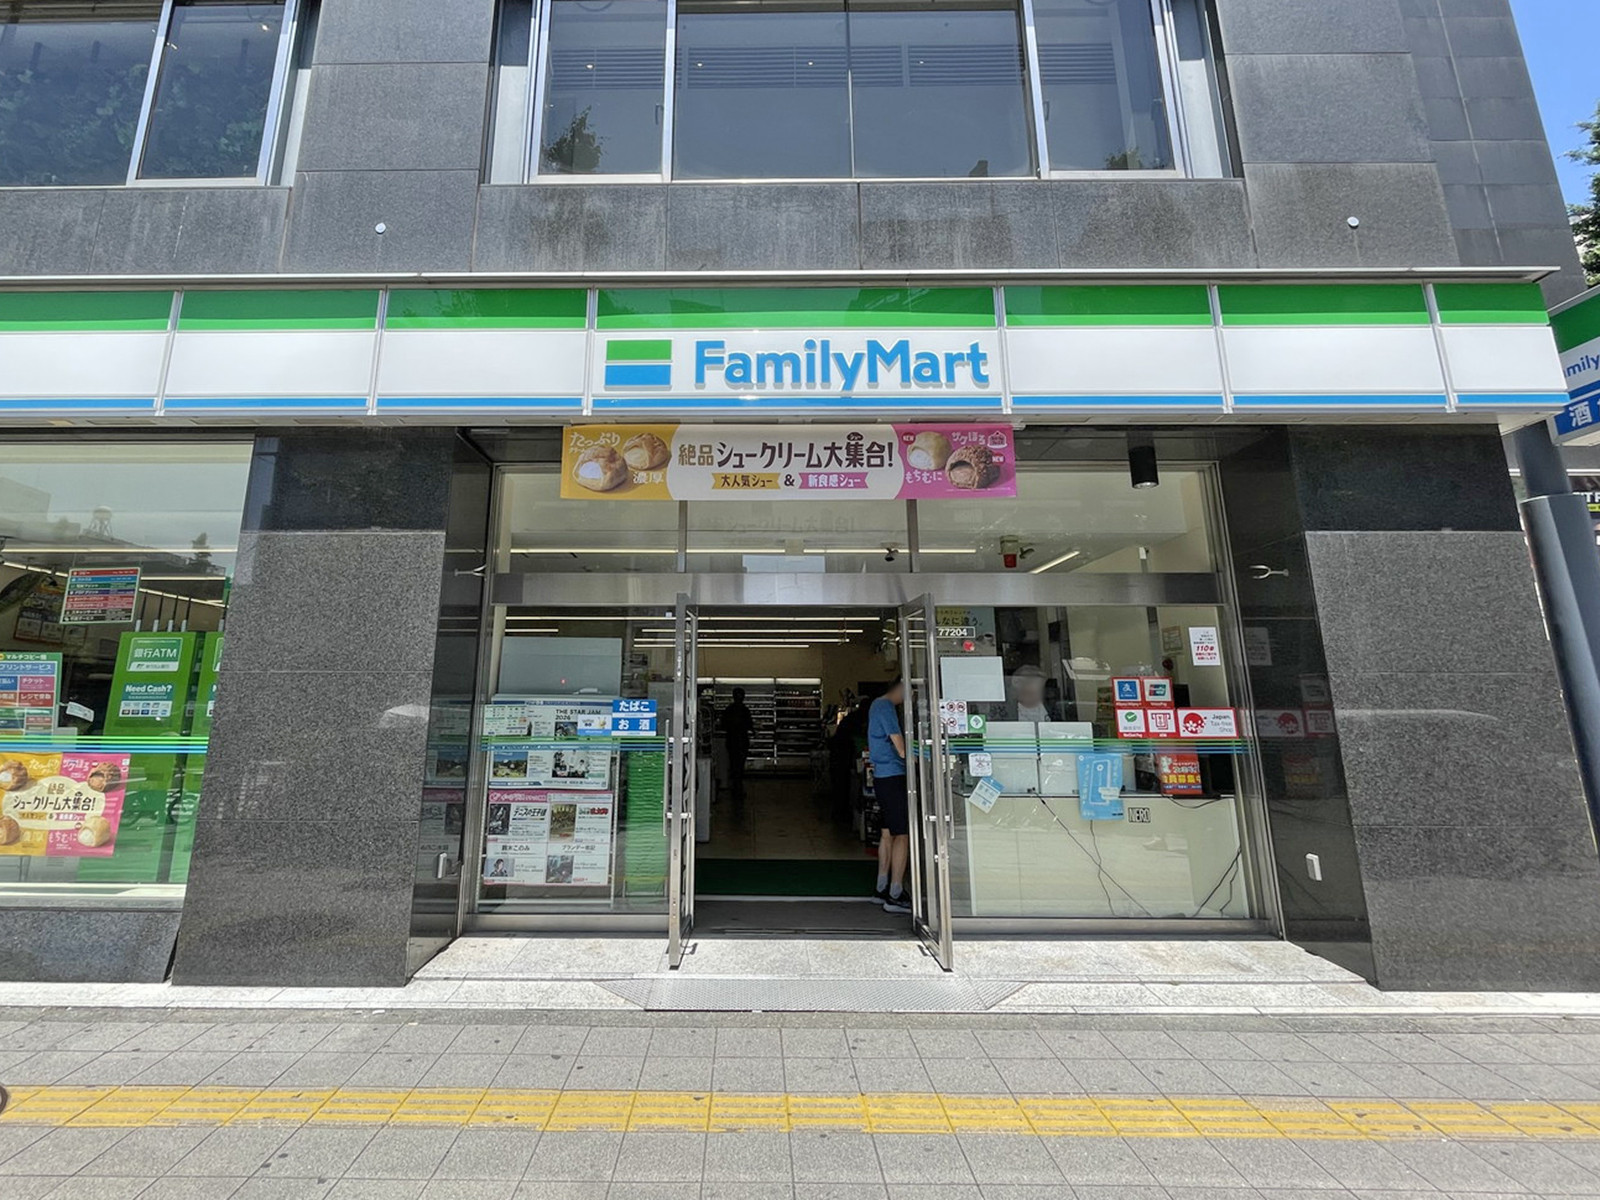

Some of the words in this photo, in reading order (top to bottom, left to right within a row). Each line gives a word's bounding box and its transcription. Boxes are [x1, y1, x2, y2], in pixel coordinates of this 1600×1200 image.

[695, 338, 990, 391] FamilyMart
[1563, 354, 1600, 378] mily
[570, 432, 621, 447] たっぷり
[951, 431, 986, 446] ザクほろ
[632, 471, 664, 485] 濃厚
[721, 474, 773, 488] 大人気シュー
[783, 474, 796, 487] &
[807, 473, 862, 488] 新食感シュー
[904, 469, 943, 484] もちむに
[938, 628, 968, 637] 77204
[134, 648, 178, 659] 銀行ATM
[125, 684, 146, 693] Need
[147, 684, 173, 693] Cash?
[619, 700, 650, 712] たばこ
[12, 795, 97, 812] シュークリーム大集合!
